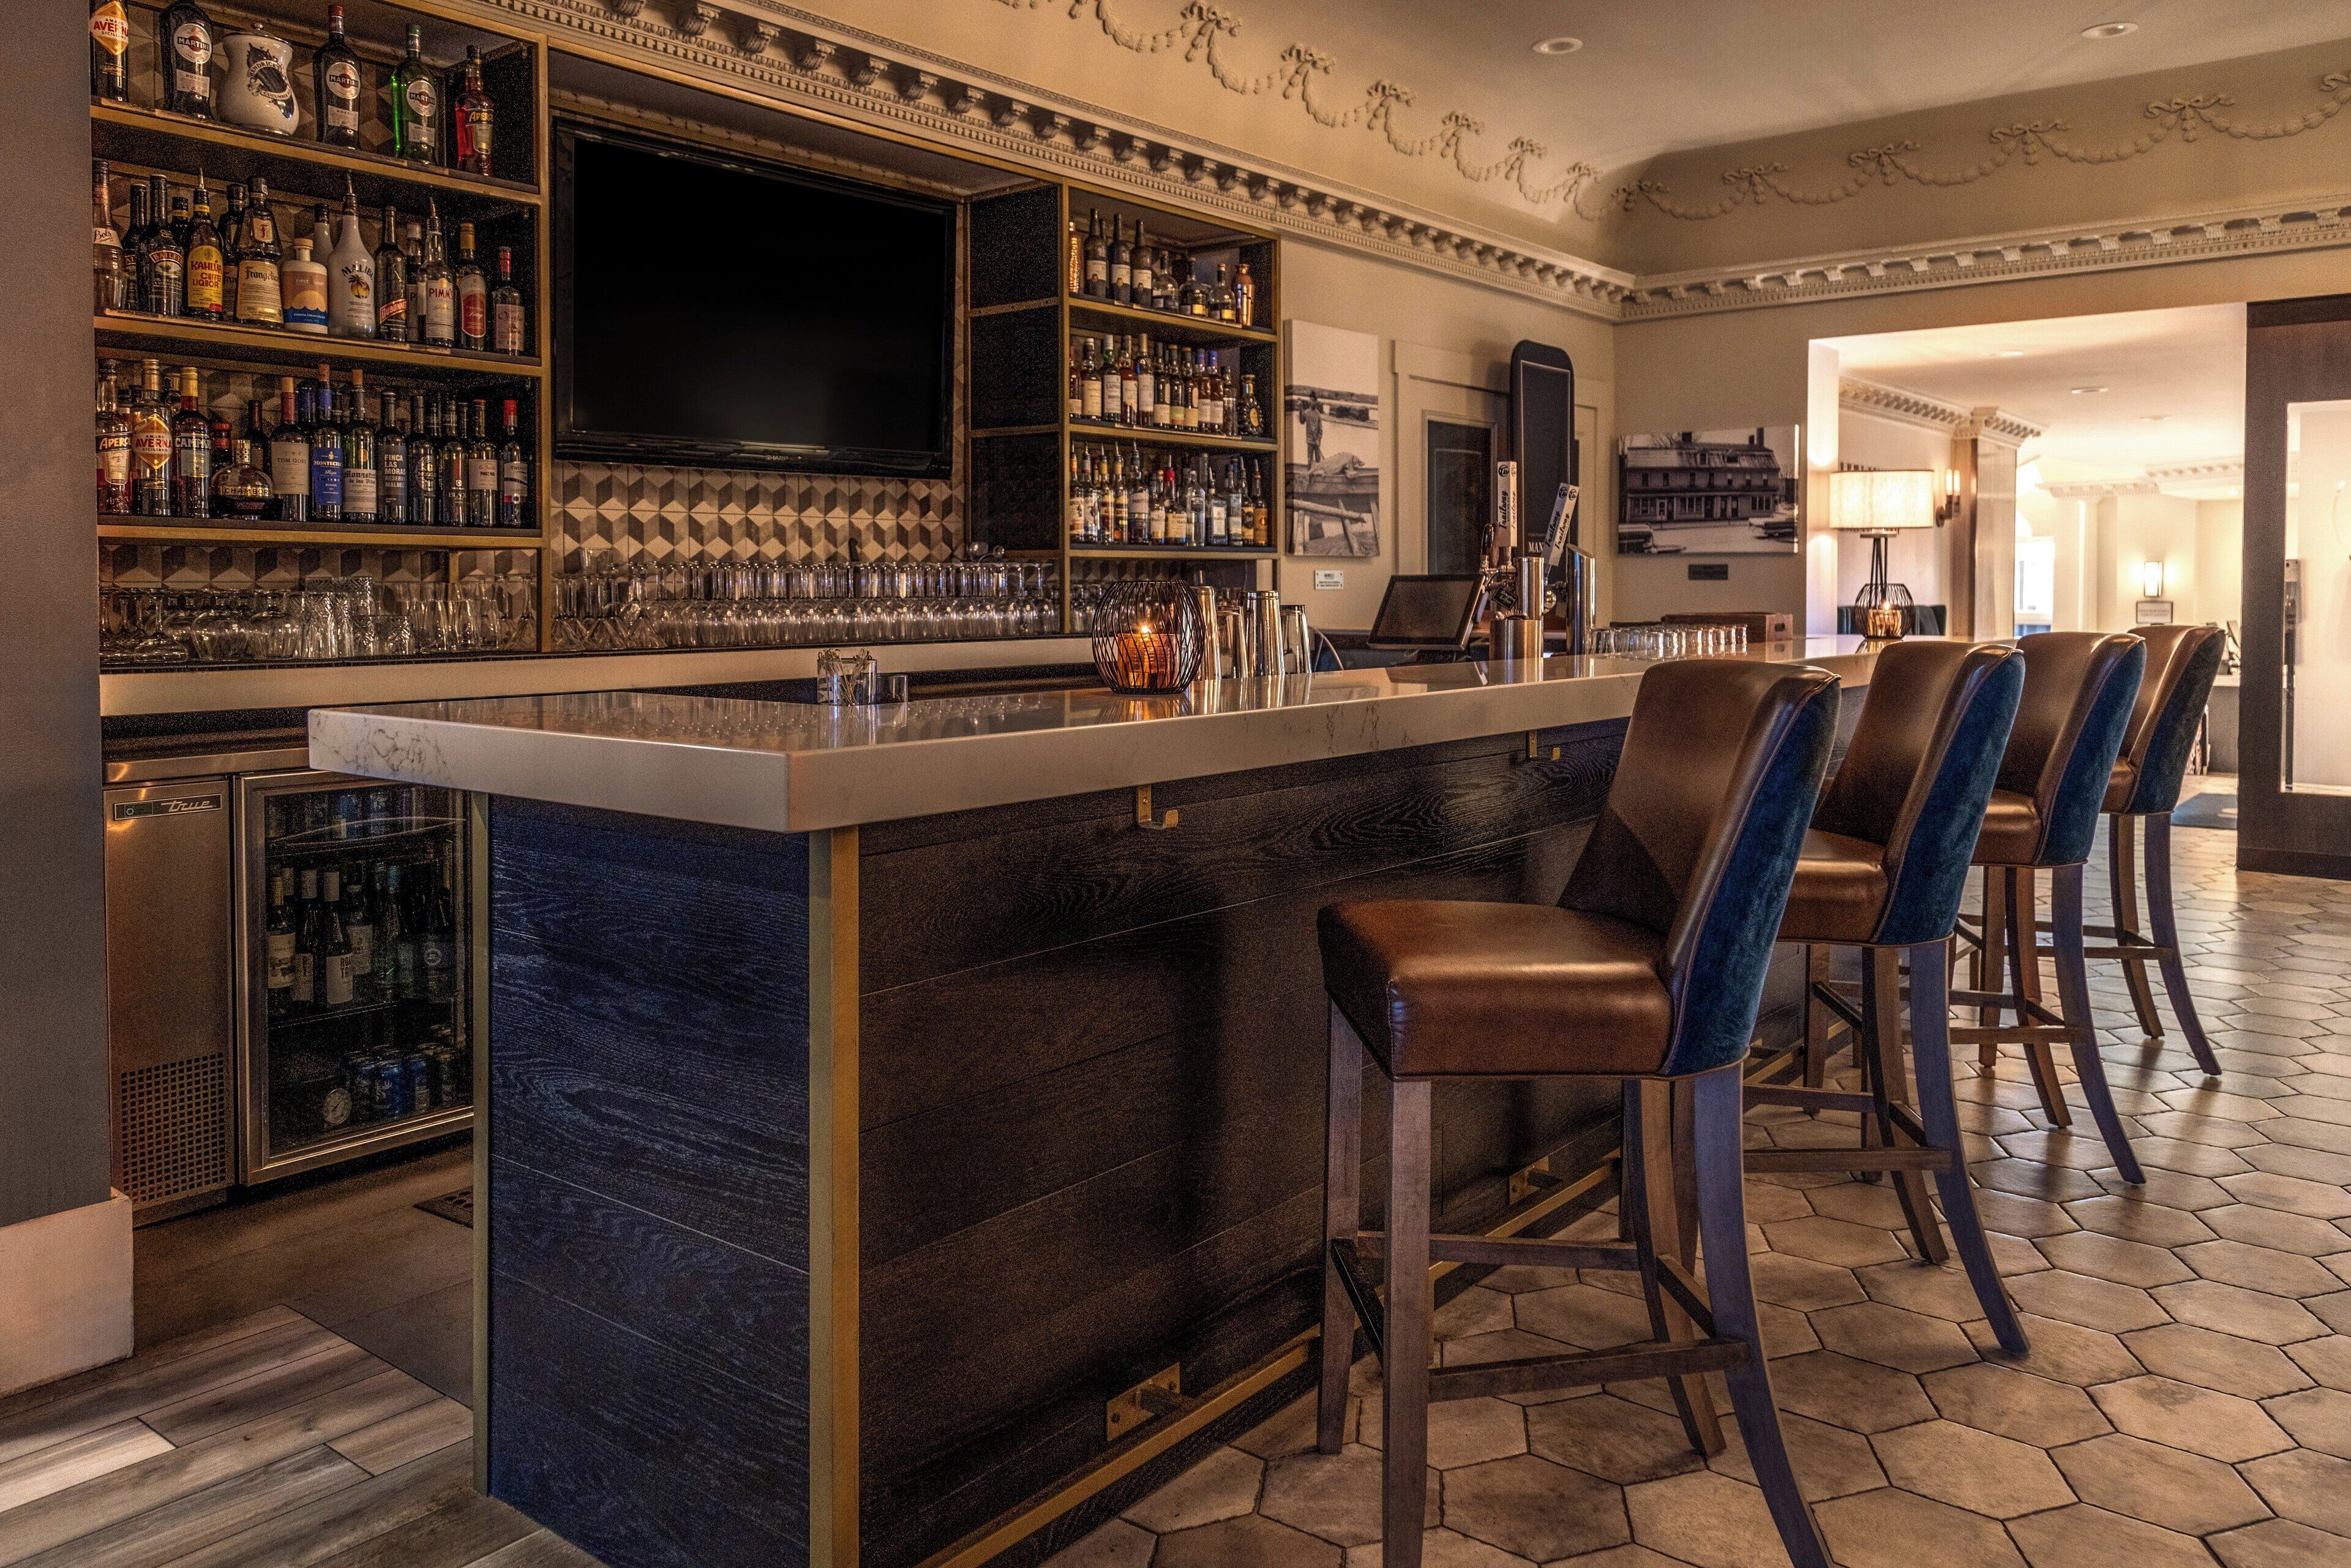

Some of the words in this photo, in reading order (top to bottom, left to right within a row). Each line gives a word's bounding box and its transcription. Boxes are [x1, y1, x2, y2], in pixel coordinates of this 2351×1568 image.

[178, 37, 209, 51] MARTINI
[330, 75, 359, 88] MARTINI
[410, 92, 435, 105] MARTINI
[192, 279, 219, 288] LIQUOR
[135, 438, 172, 448] AVERNA
[1498, 489, 1509, 530] Trailway
[1554, 512, 1570, 550] Trailway
